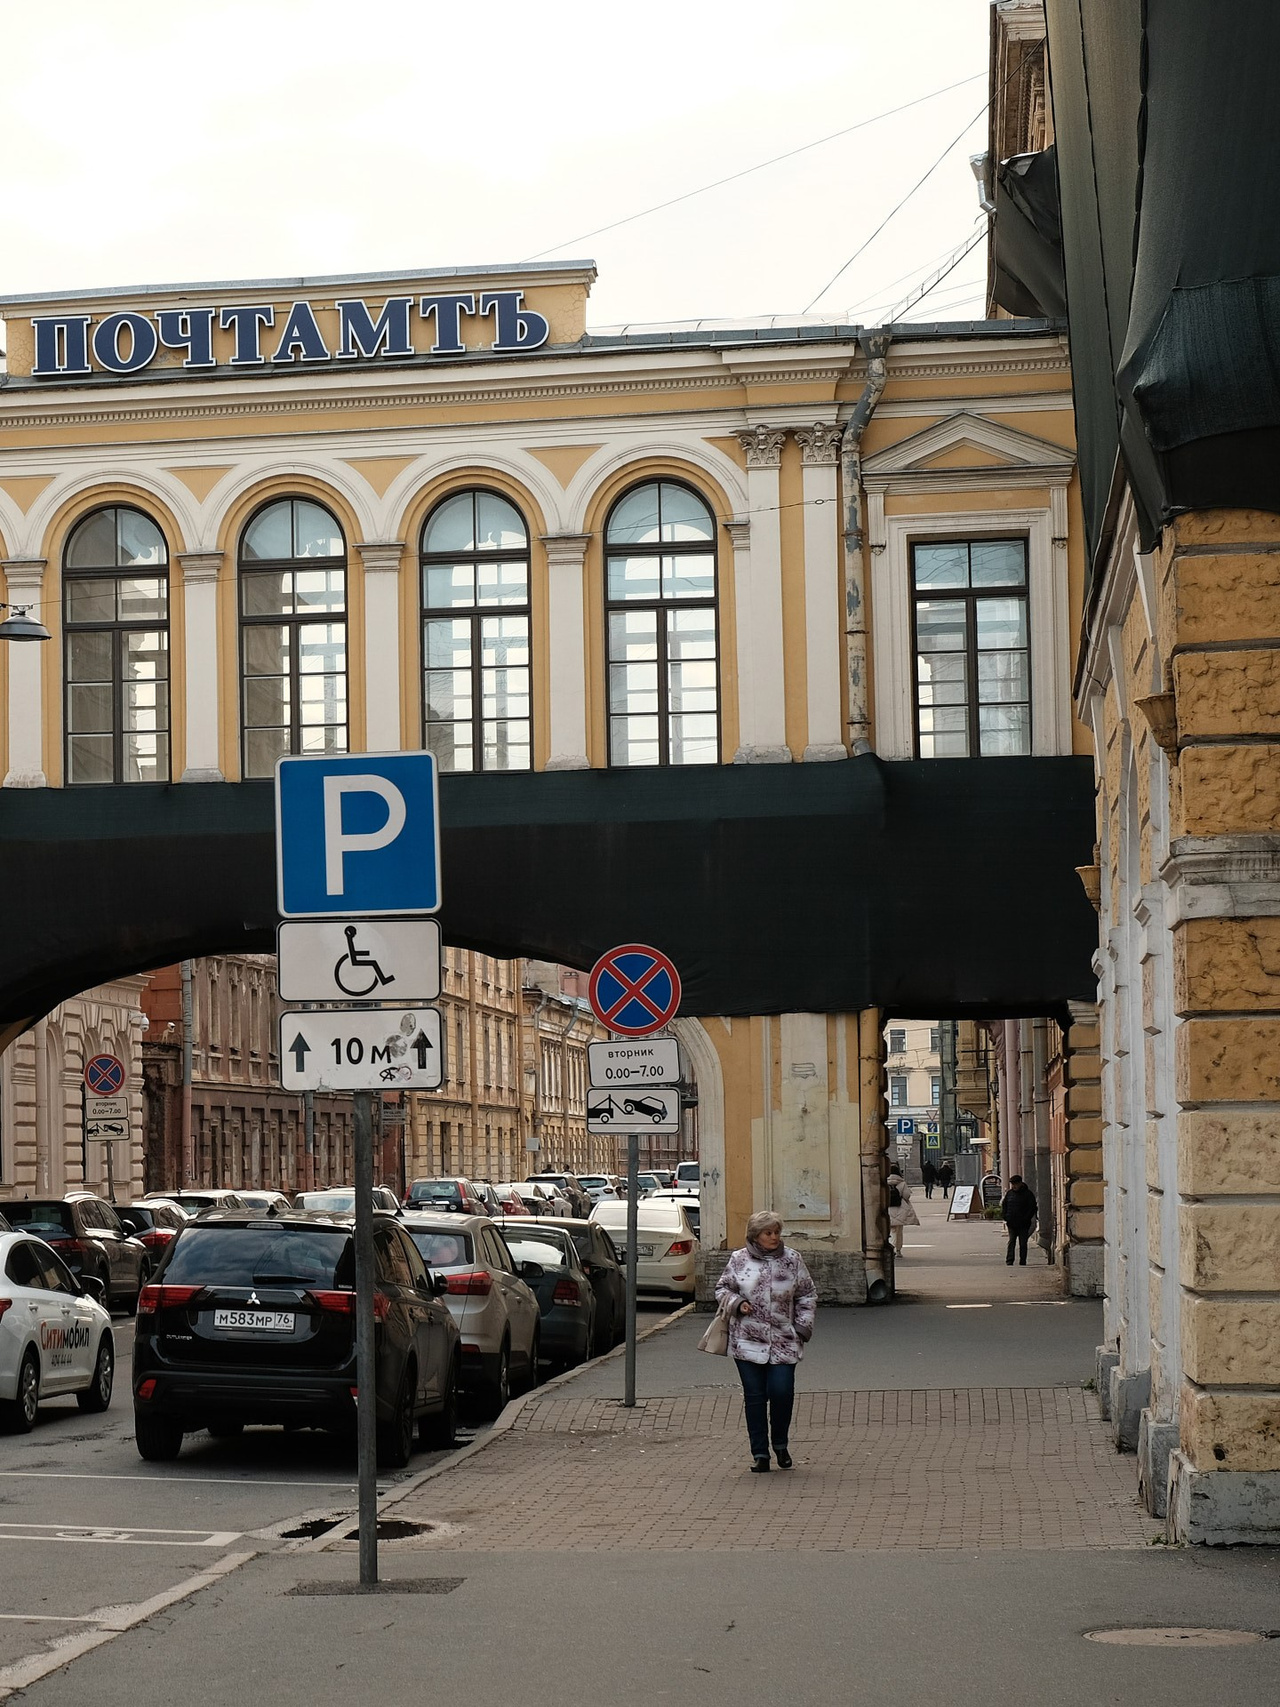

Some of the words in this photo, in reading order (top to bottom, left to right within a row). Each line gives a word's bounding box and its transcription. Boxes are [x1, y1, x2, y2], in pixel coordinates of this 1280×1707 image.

[31, 289, 550, 376] ПОЧТАМТЪ
[323, 774, 407, 896] P
[330, 1037, 363, 1065] 10
[608, 1049, 654, 1059] вторник
[219, 1312, 272, 1326] М583МР
[277, 1313, 290, 1324] 76
[41, 1319, 90, 1350] Ситимобил
